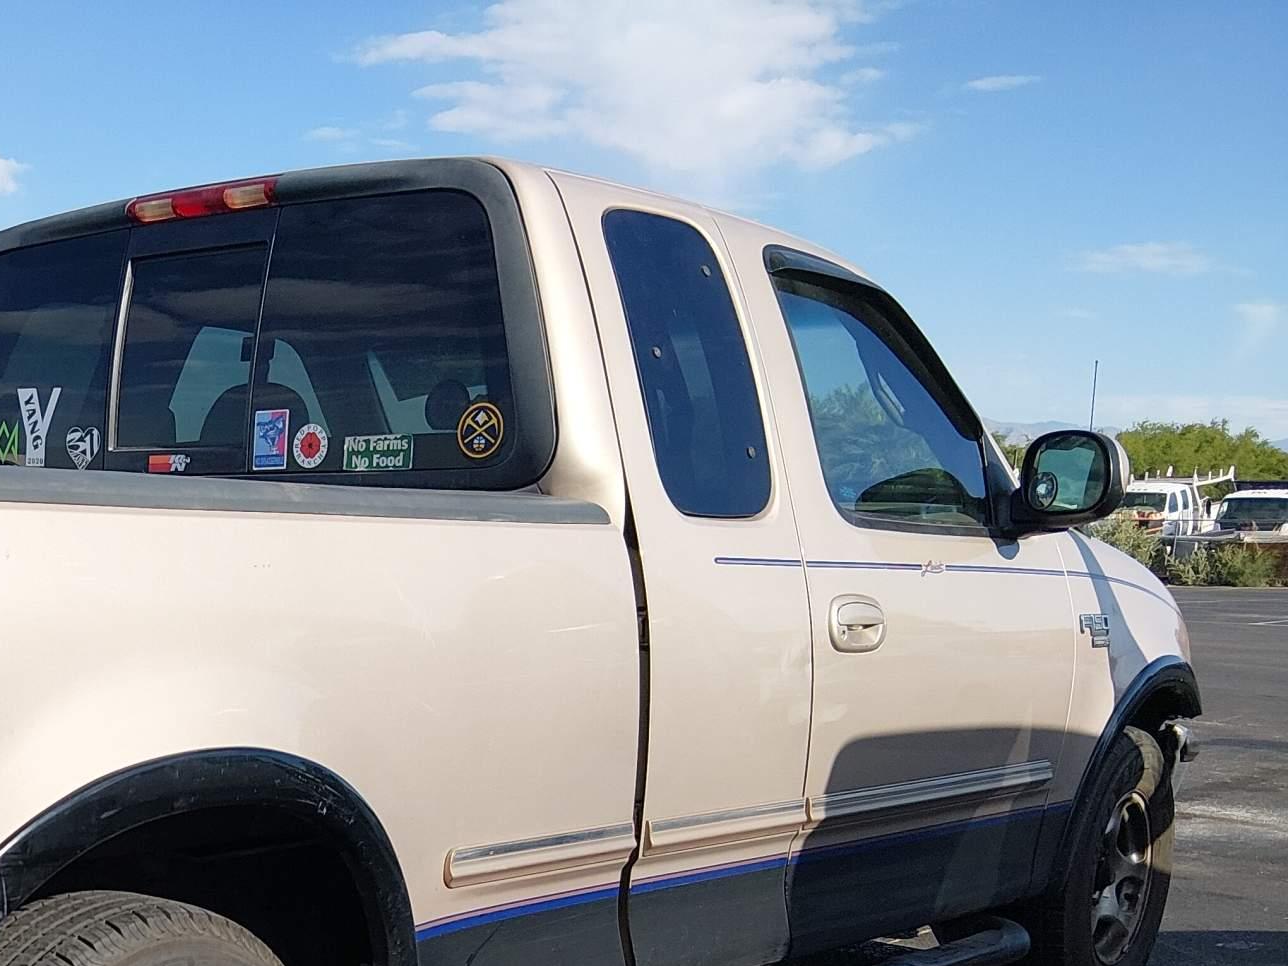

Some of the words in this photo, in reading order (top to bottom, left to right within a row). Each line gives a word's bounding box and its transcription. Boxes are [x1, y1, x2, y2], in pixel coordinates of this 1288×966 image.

[23, 393, 43, 451] YANG
[307, 425, 327, 448] POPPY
[348, 438, 367, 452] No
[369, 438, 409, 451] Farms
[27, 457, 45, 465] 2020
[296, 452, 324, 466] RANCH
[351, 454, 369, 468] No
[372, 451, 404, 467] Food
